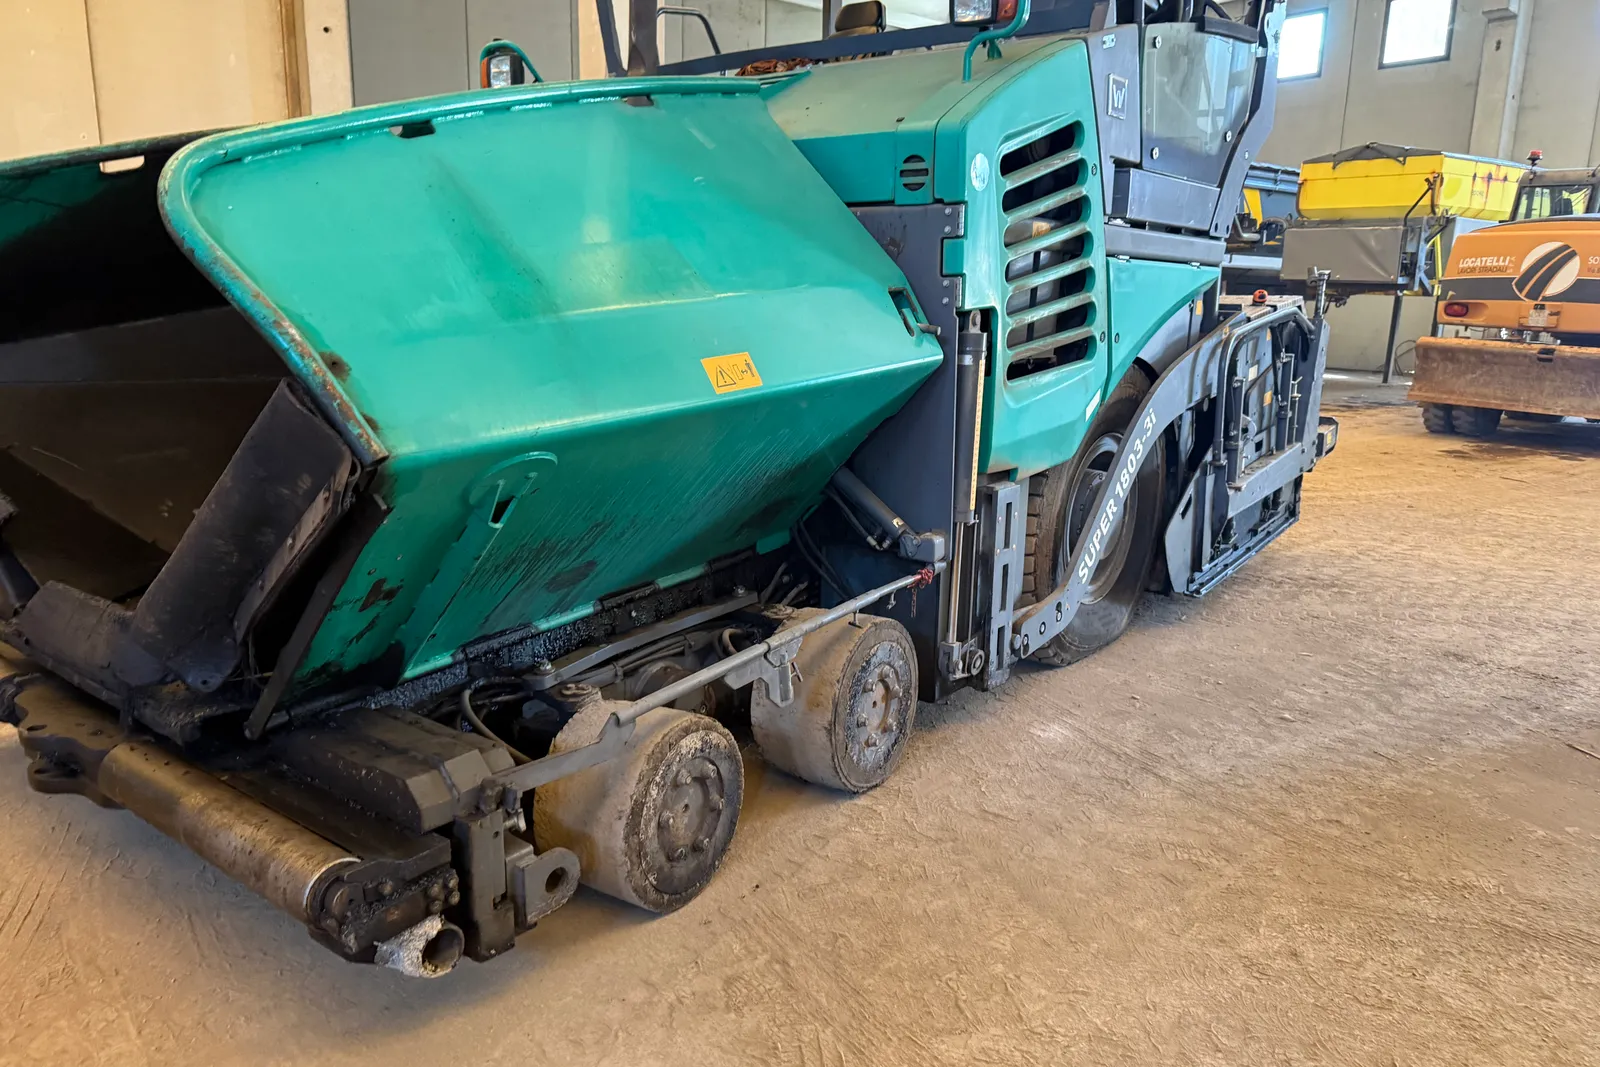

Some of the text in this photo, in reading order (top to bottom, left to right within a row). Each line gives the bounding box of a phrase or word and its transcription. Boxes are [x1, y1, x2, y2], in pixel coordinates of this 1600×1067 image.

[1112, 84, 1126, 109] W
[1458, 256, 1510, 268] LOCATELLI
[1078, 408, 1157, 584] SUPER 1803-3i
